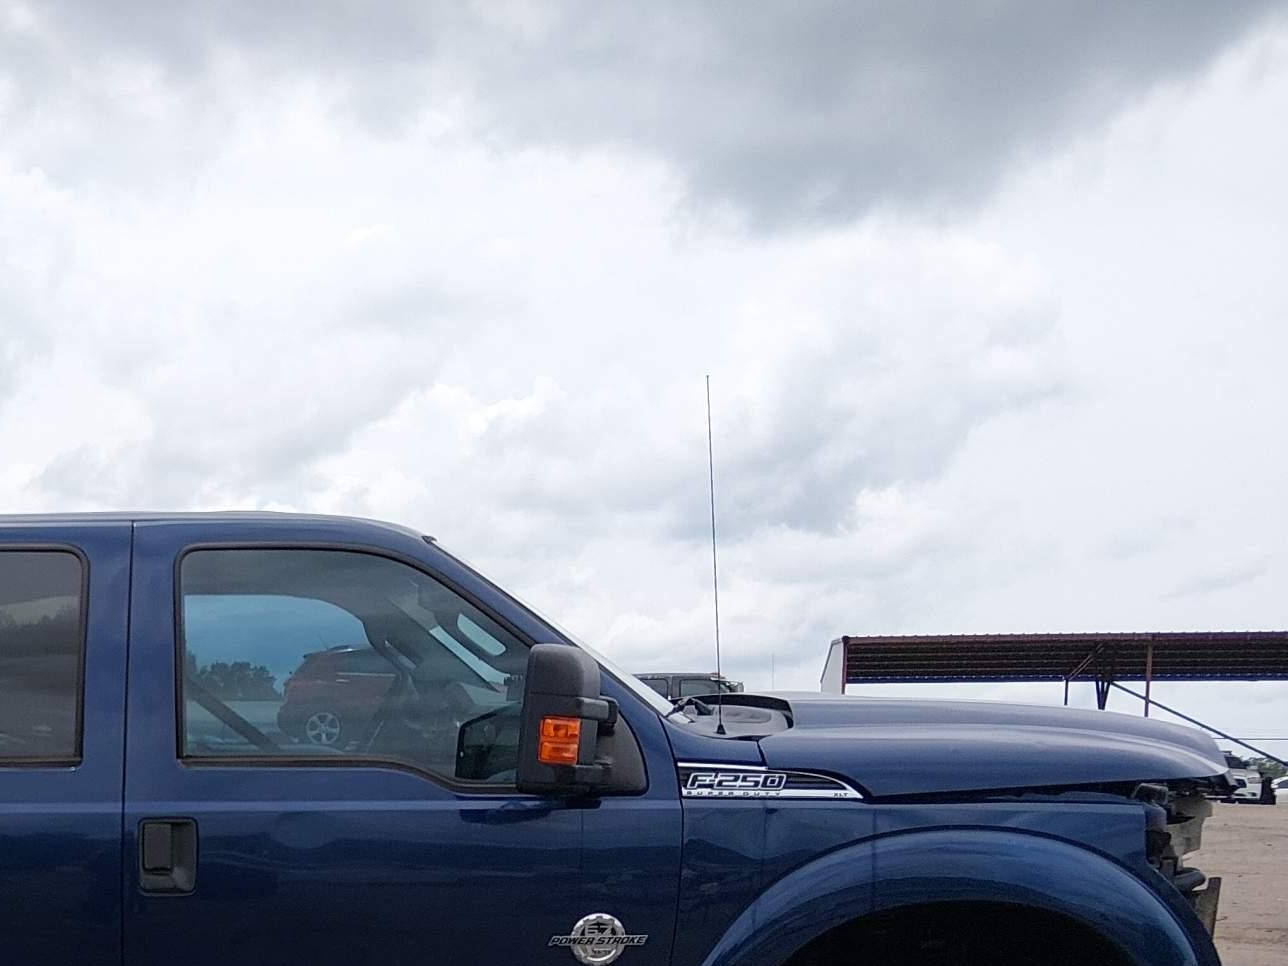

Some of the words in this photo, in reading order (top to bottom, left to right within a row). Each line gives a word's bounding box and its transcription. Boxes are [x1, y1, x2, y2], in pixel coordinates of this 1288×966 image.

[687, 772, 786, 790] F-250
[551, 936, 595, 945] POWER
[595, 936, 646, 945] STROKE
